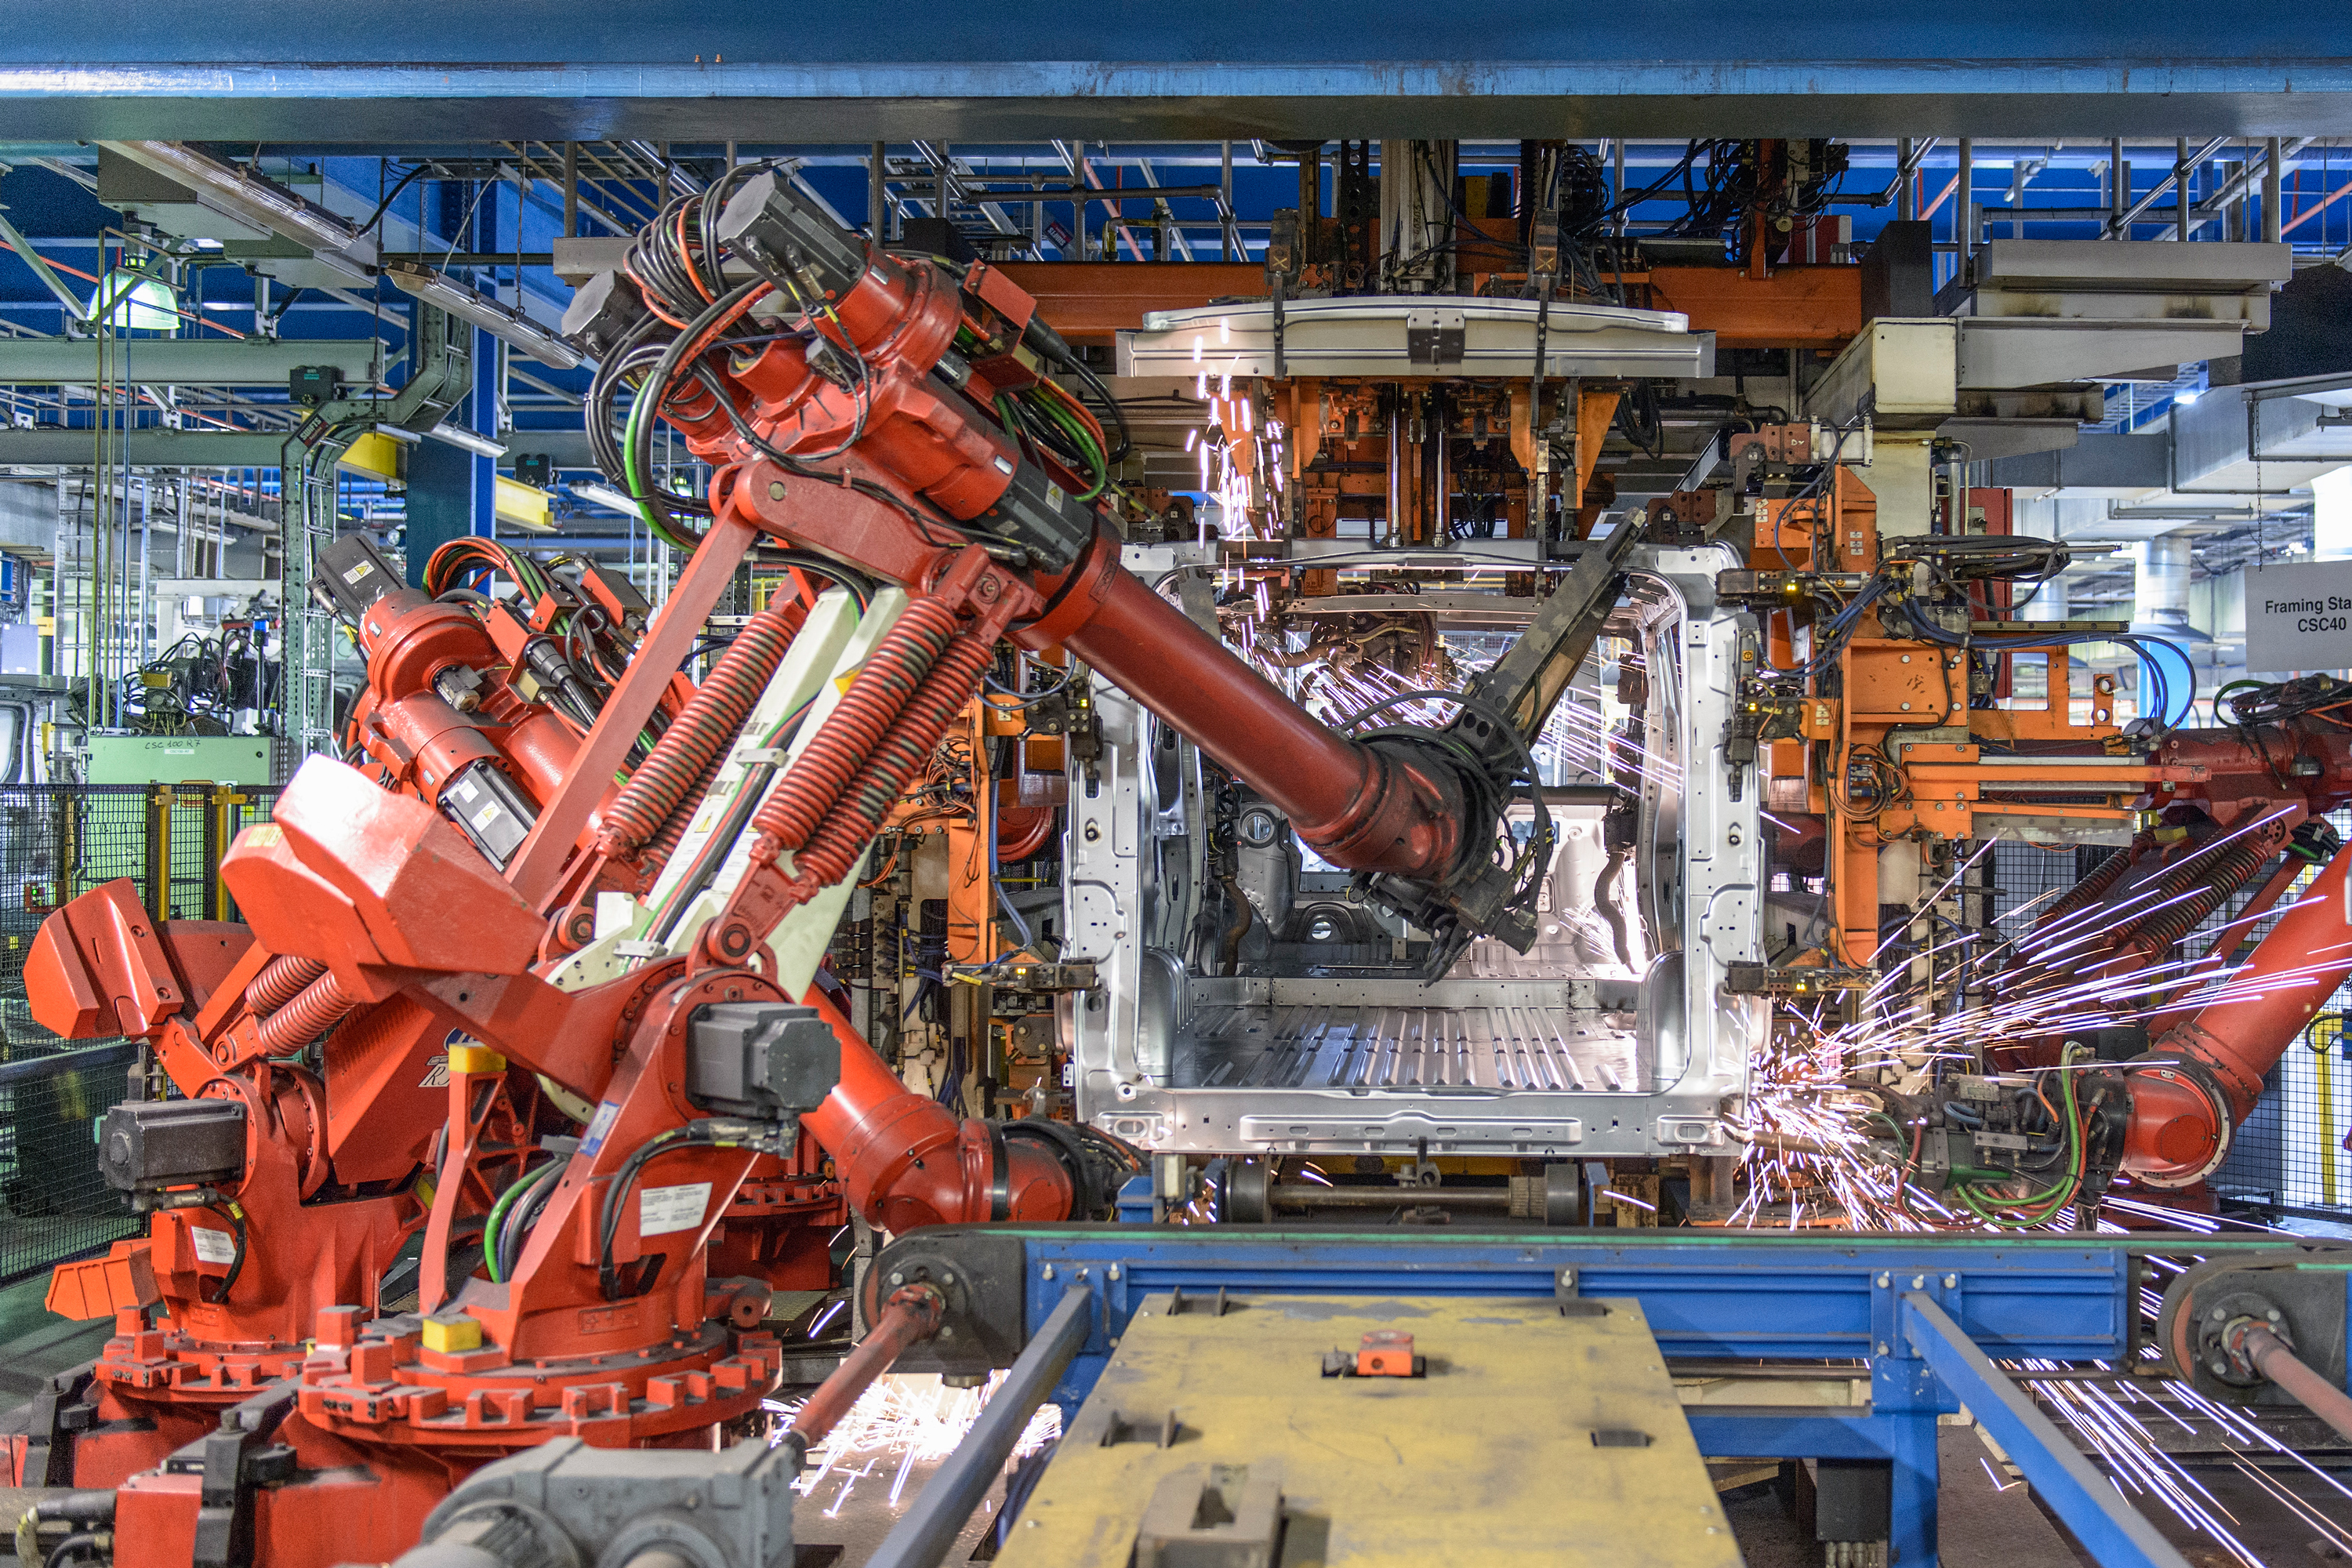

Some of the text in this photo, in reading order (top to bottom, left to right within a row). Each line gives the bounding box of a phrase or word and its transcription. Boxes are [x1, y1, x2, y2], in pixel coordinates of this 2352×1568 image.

[1047, 227, 1066, 246] SWIFTS
[299, 417, 322, 441] SWIFTS
[2266, 597, 2352, 615] Framing Sta
[2298, 617, 2347, 632] CSC40
